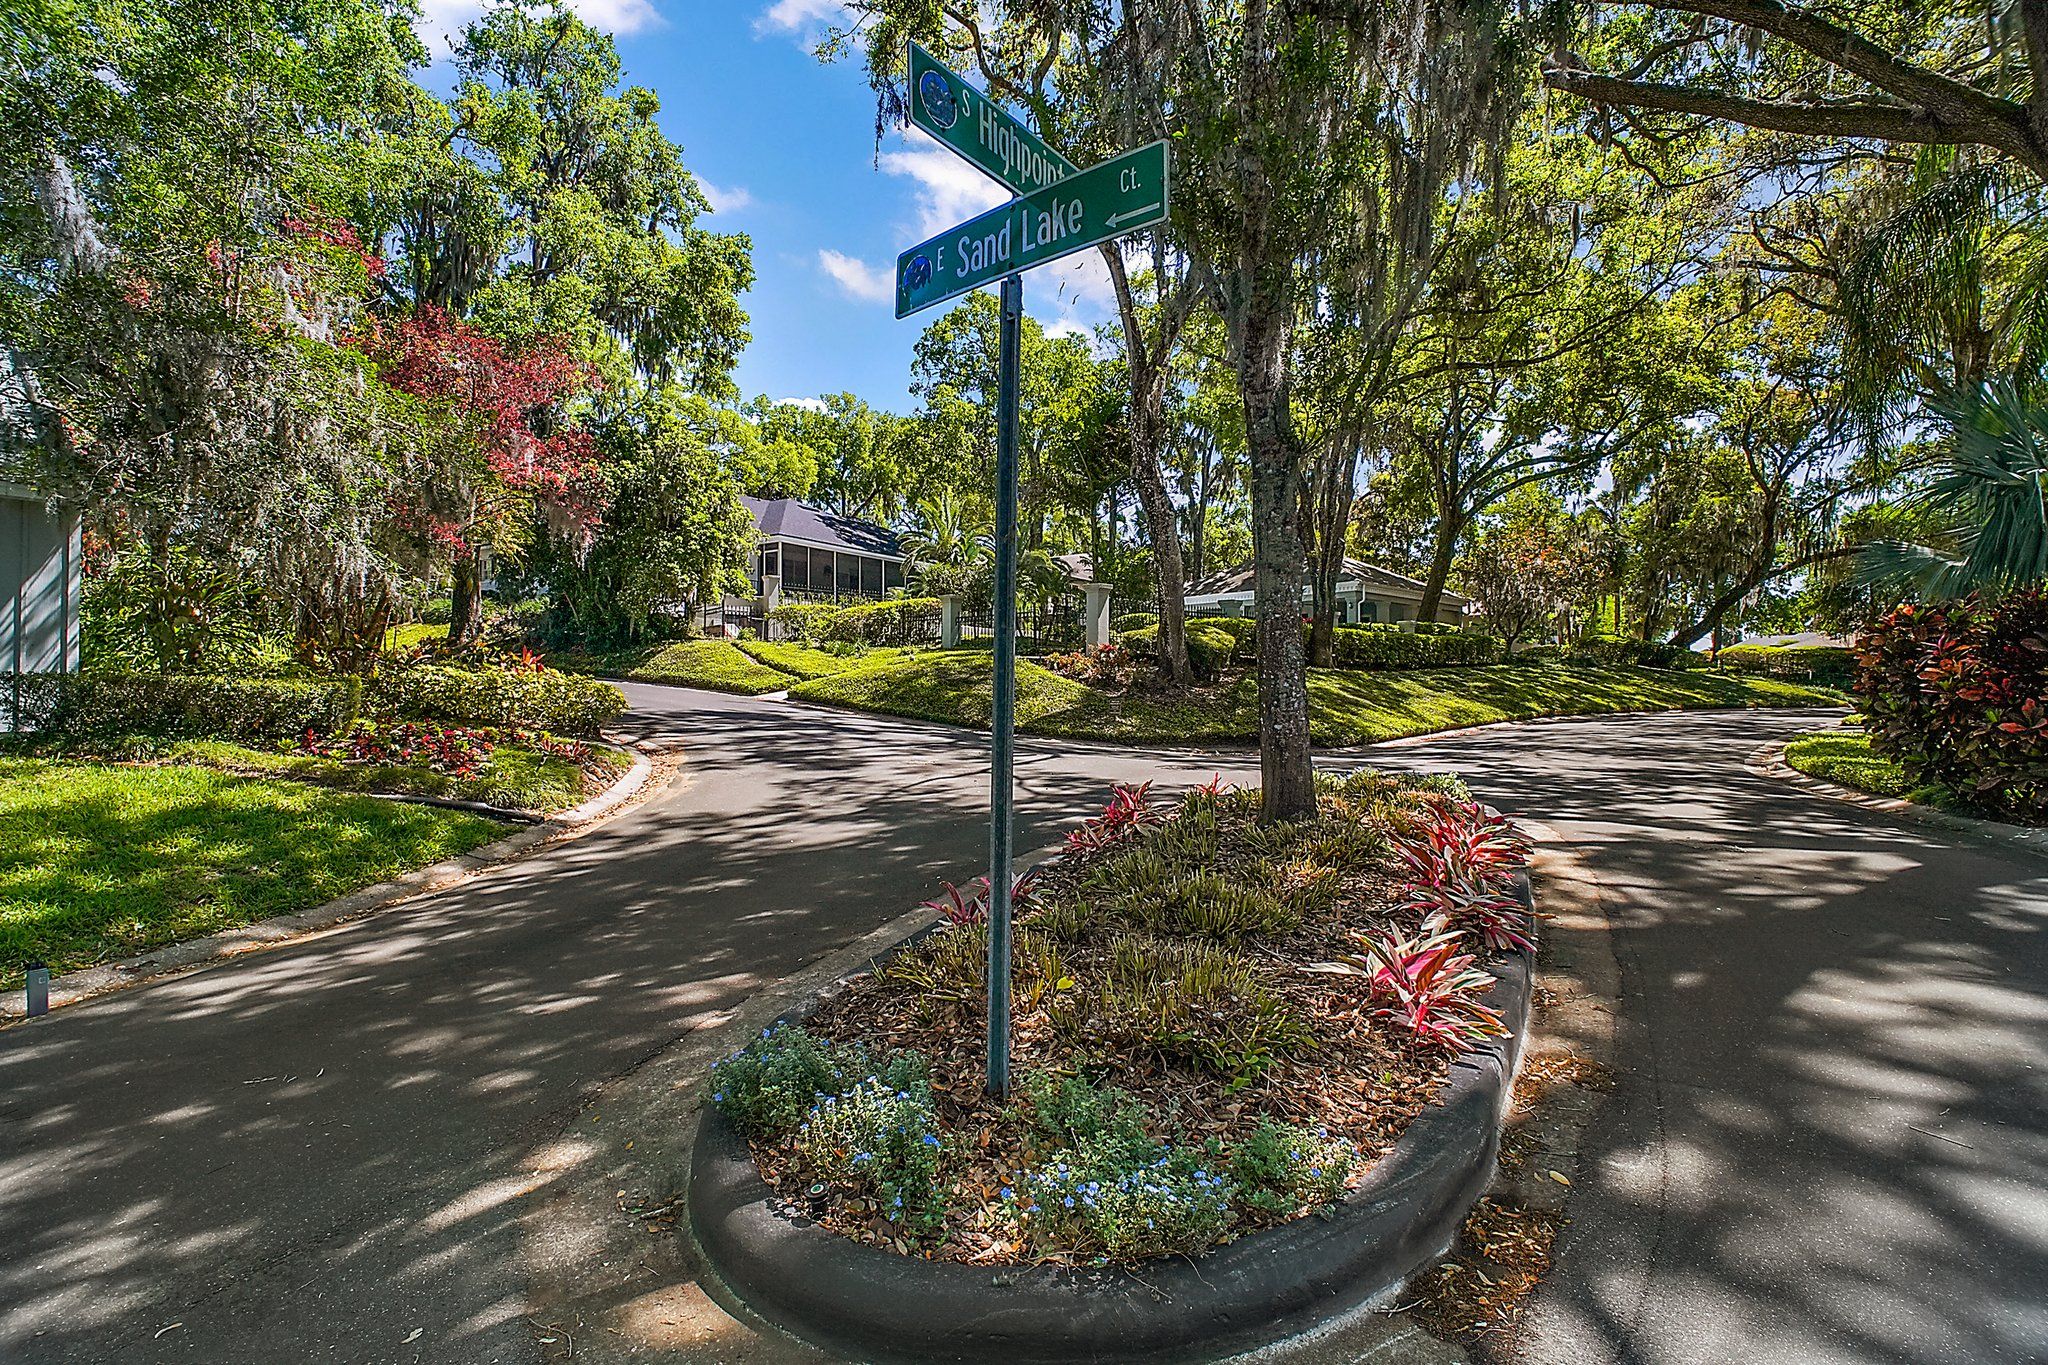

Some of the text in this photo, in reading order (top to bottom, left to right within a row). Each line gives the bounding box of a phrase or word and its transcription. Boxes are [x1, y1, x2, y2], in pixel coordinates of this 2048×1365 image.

[962, 89, 971, 118] S
[937, 166, 1141, 278] E Sand Lake Ct.
